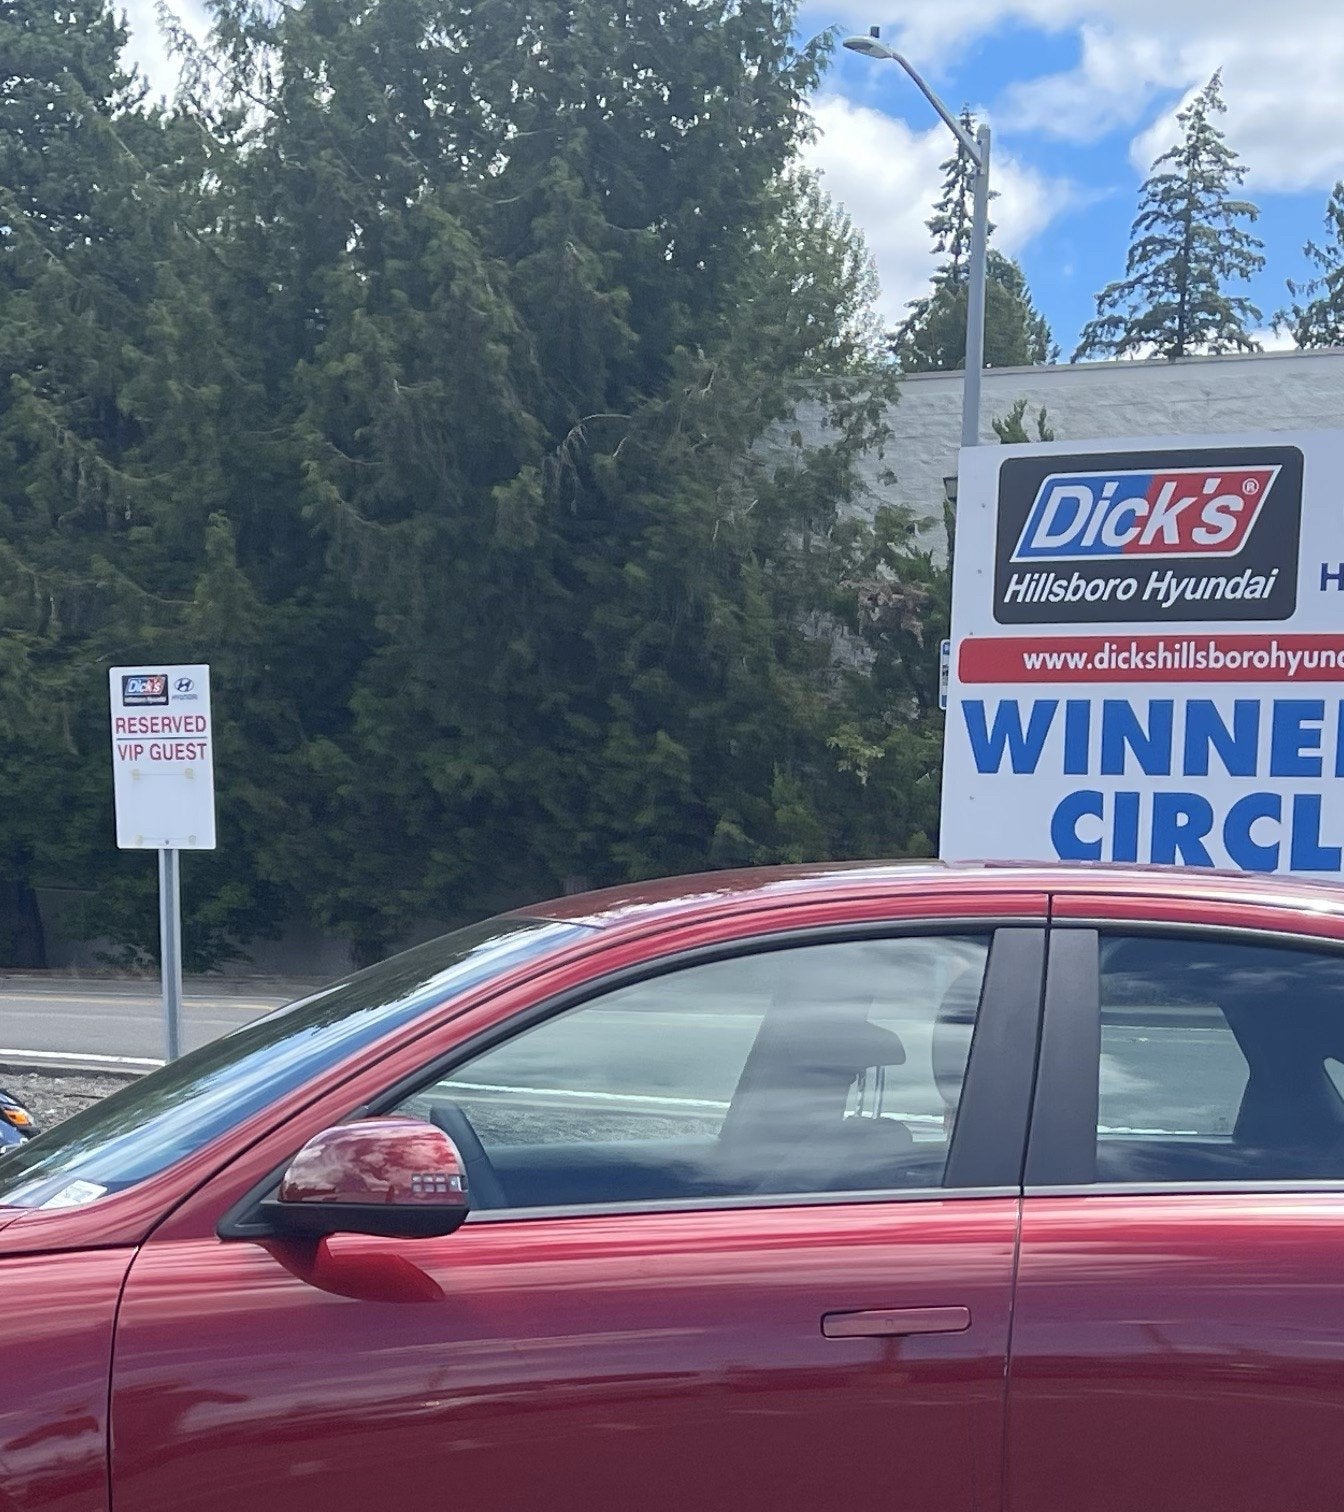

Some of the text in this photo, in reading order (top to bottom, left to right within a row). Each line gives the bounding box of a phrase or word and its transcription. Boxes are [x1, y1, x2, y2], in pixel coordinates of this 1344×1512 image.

[1003, 568, 1280, 608] Hillsboro Hyundai
[115, 715, 207, 735] RESERVED
[118, 743, 207, 761] VIP GUEST
